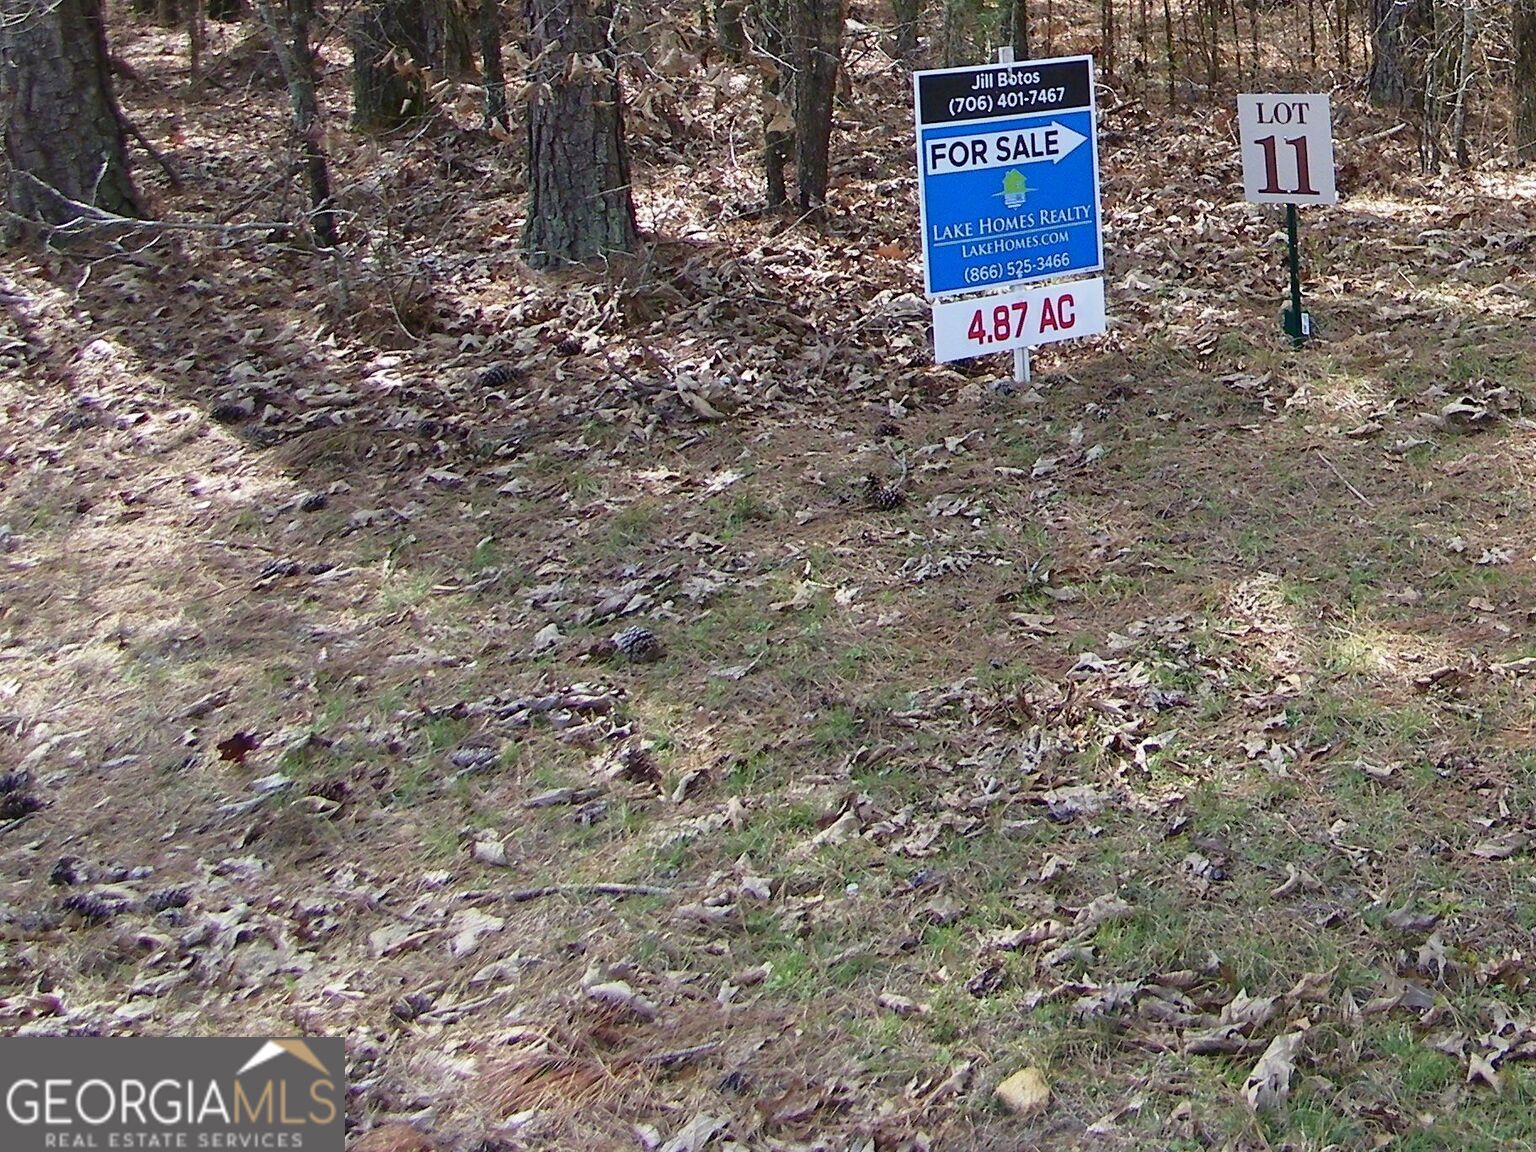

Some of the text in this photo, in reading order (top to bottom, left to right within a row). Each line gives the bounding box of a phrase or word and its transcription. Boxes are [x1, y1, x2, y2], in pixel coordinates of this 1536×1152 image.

[971, 71, 1041, 90] Jill Botos
[948, 87, 1066, 117] (706) 401-7467
[1255, 102, 1310, 124] LOT
[930, 129, 1059, 170] FOR SALE
[1253, 134, 1321, 196] 11
[964, 253, 1070, 284] (866) 525-3466
[967, 293, 1076, 345] 4.87 AC
